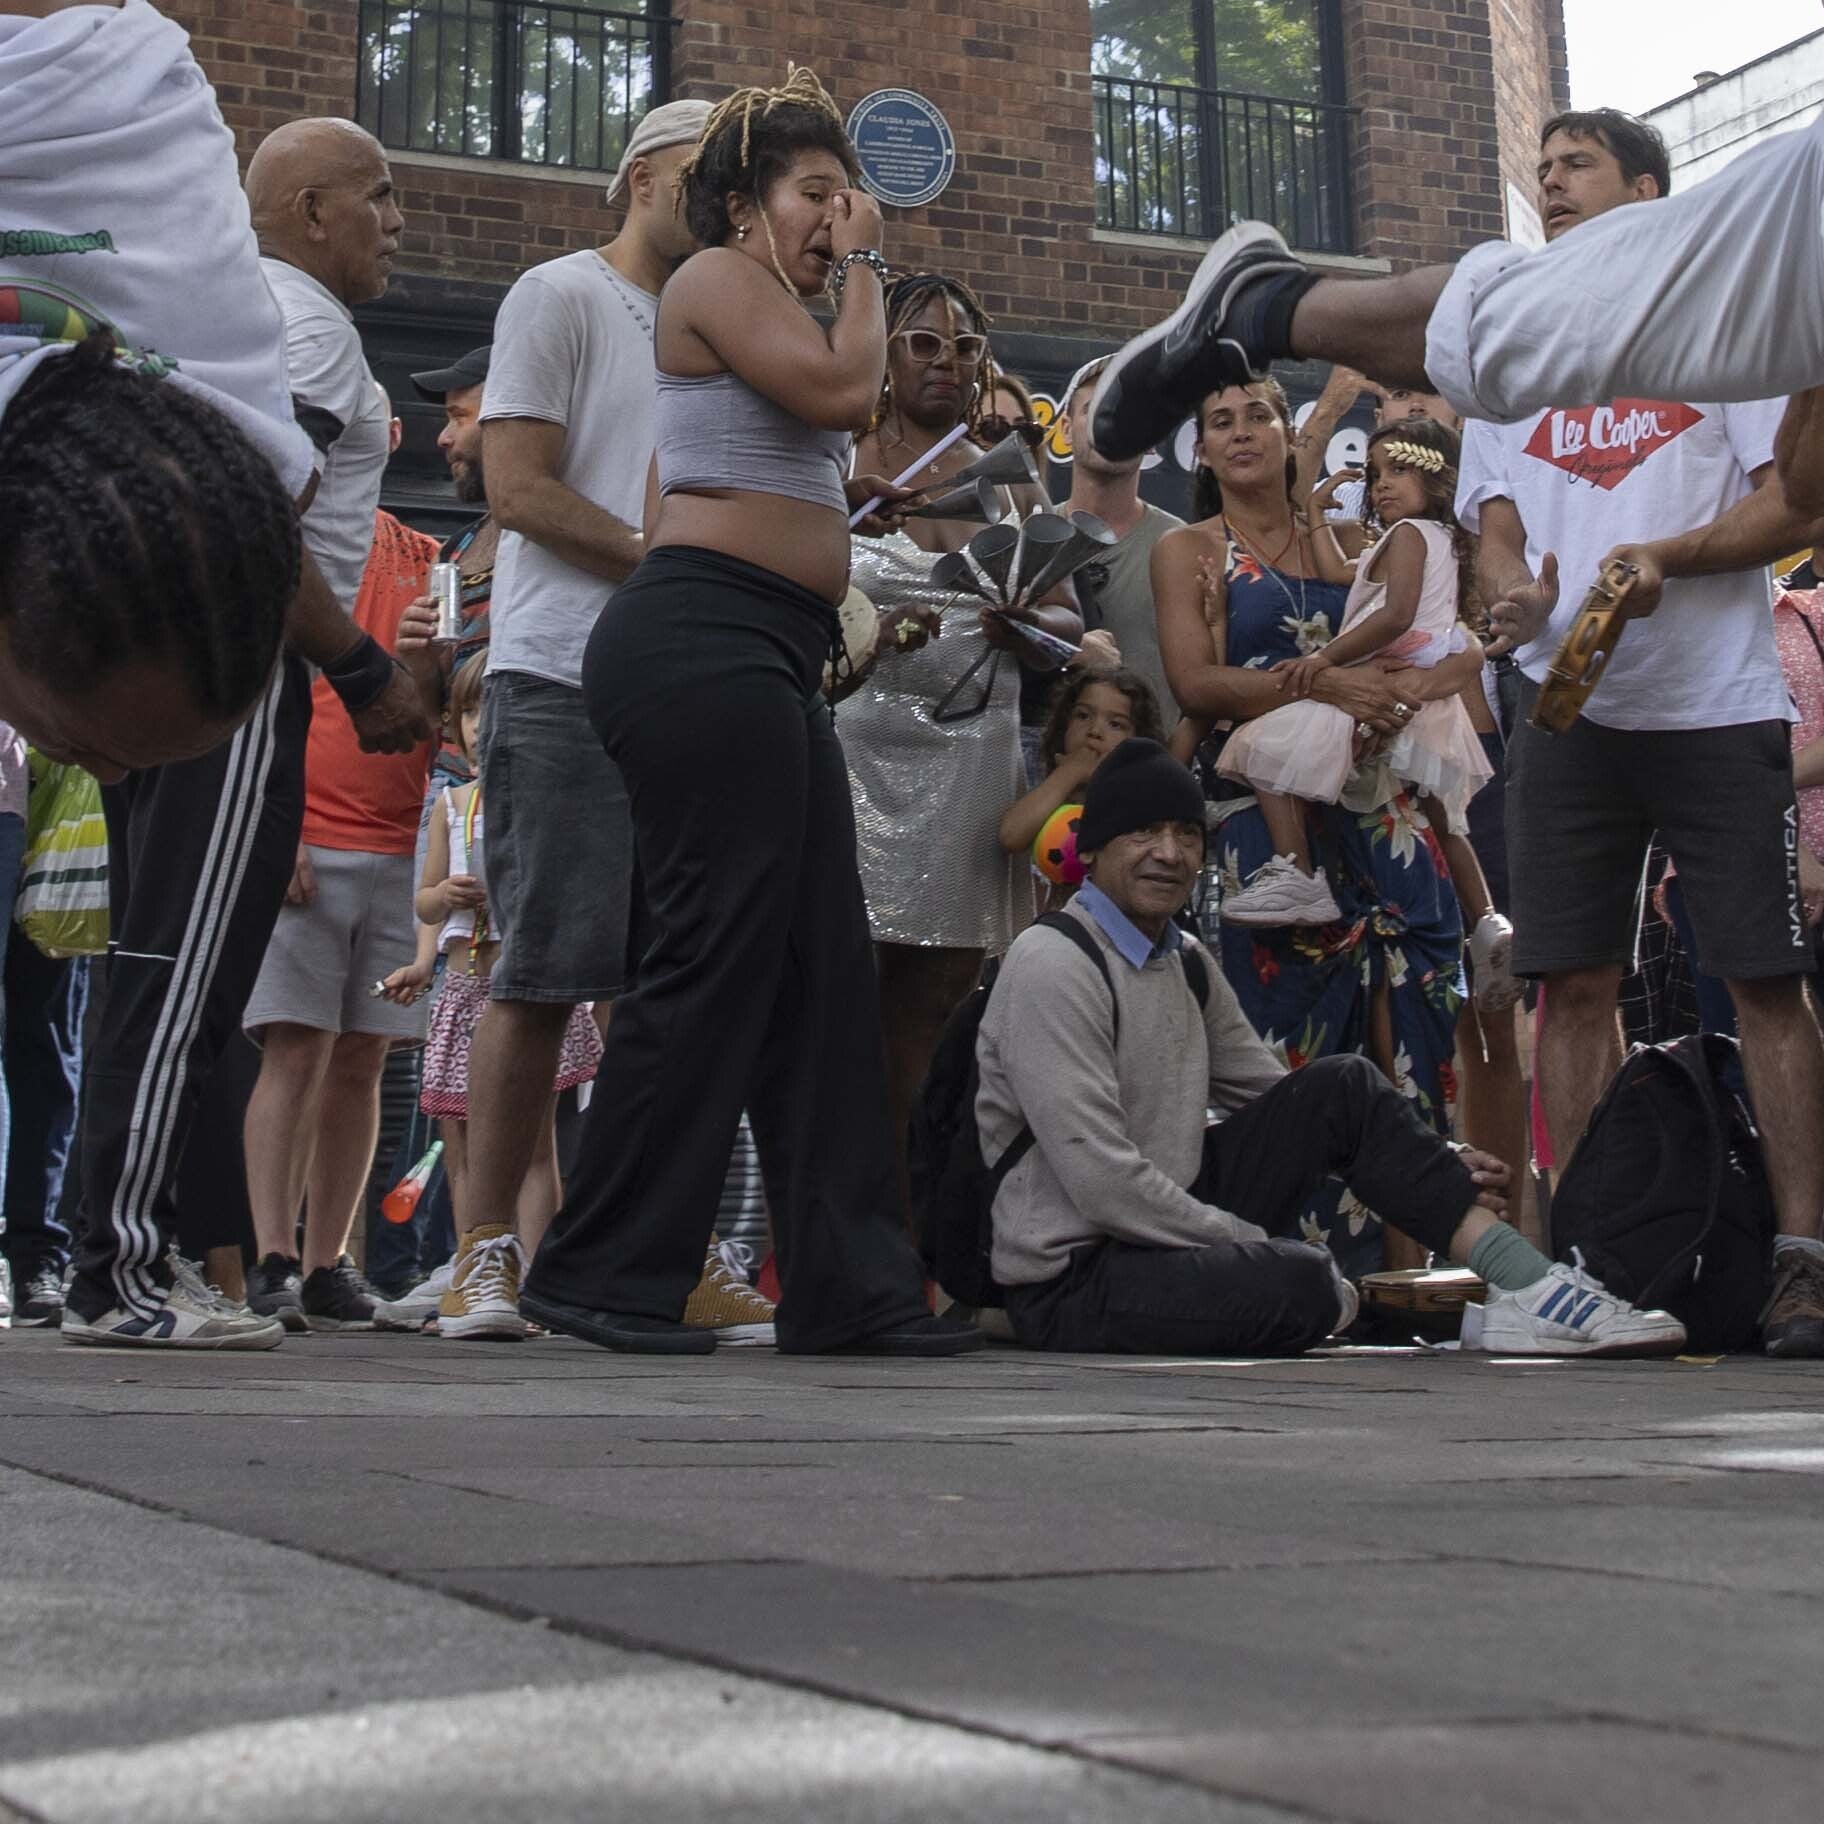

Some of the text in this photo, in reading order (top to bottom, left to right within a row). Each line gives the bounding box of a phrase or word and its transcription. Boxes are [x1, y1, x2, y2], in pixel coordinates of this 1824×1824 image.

[906, 117, 931, 128] JONES
[1550, 405, 1673, 459] Lee Cooper
[1783, 803, 1806, 947] NAUTICA
